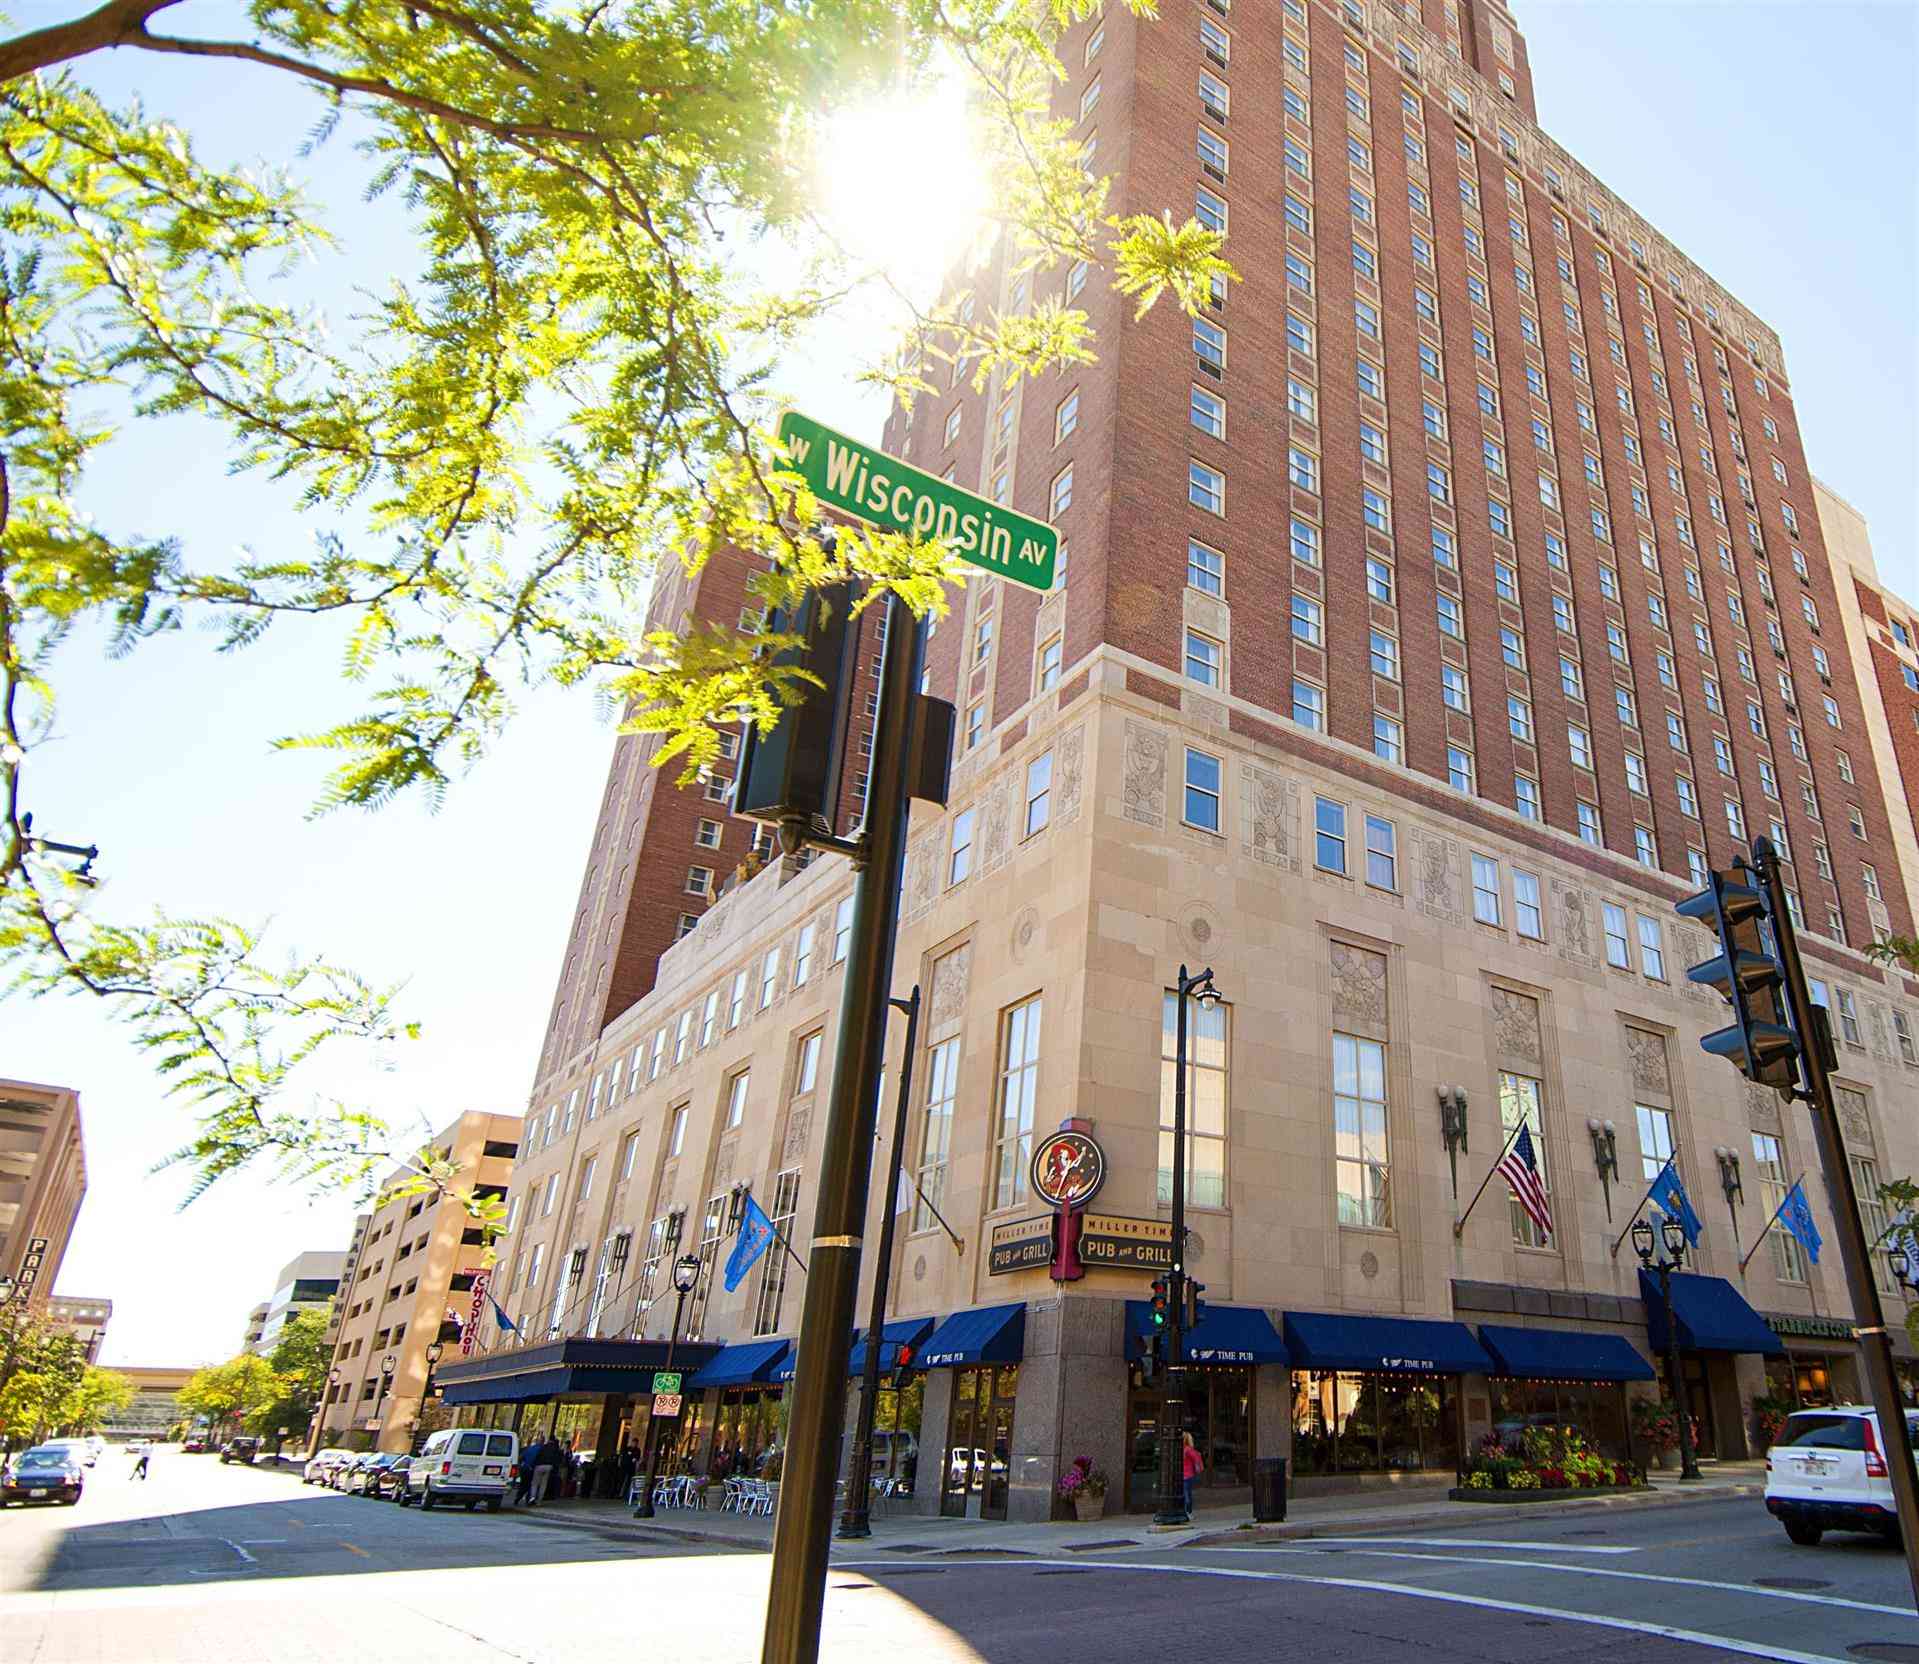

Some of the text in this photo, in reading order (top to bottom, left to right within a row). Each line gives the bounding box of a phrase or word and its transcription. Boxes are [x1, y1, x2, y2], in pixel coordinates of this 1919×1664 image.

[789, 434, 1048, 566] W Wisconsin AV
[1088, 1220, 1138, 1232] MILLER
[994, 1250, 1011, 1267] PUB
[1023, 1243, 1047, 1260] GRILL
[1087, 1241, 1115, 1257] PUB
[1136, 1246, 1172, 1263] GRILL
[1217, 1351, 1236, 1361] TIME
[1239, 1351, 1254, 1361] PUB
